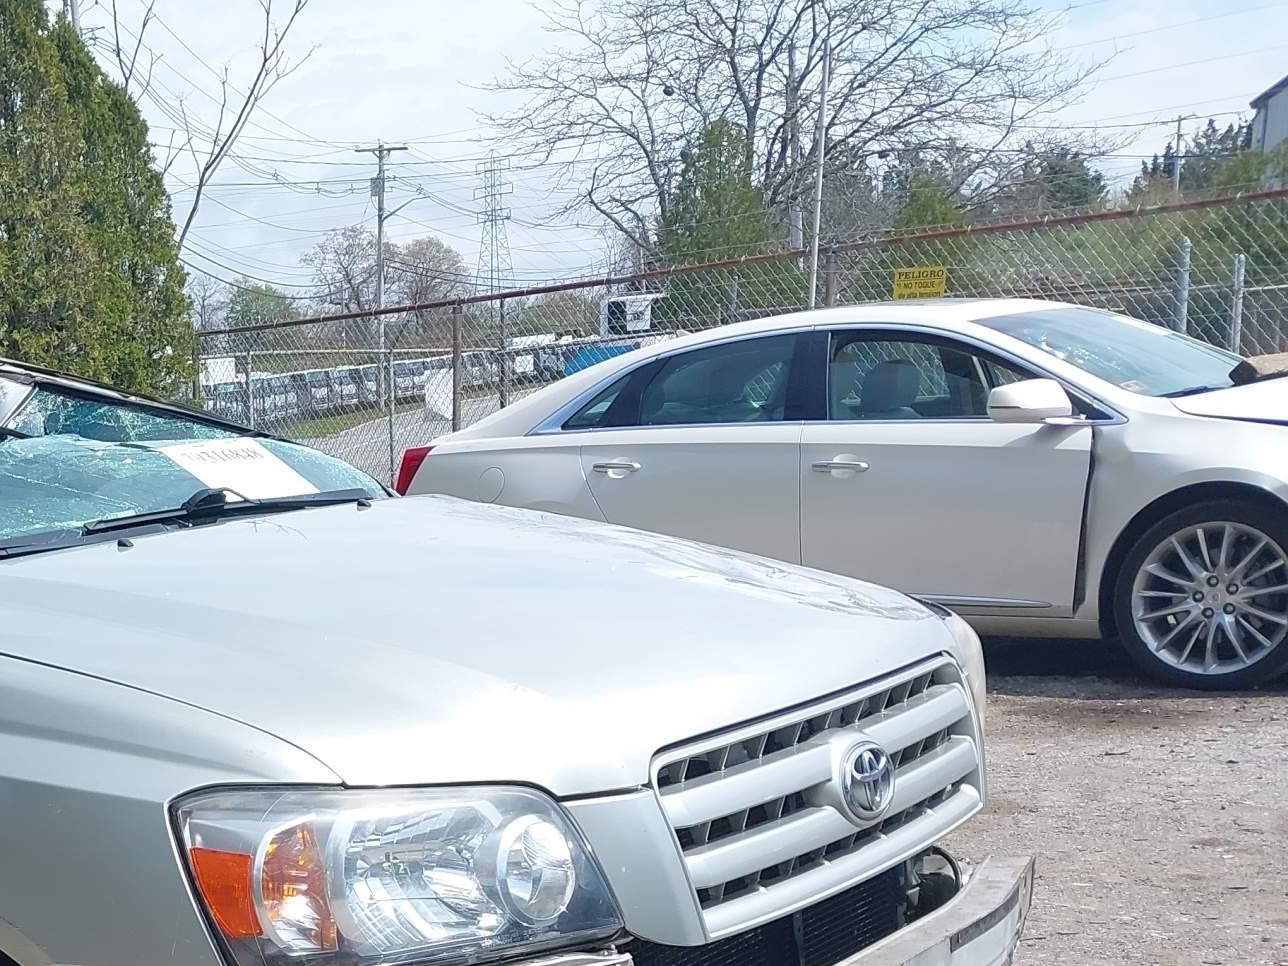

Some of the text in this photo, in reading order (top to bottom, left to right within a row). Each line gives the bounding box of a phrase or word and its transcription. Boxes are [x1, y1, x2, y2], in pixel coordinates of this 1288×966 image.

[898, 270, 944, 279] PELIGRO
[904, 281, 936, 289] NO TOQUE
